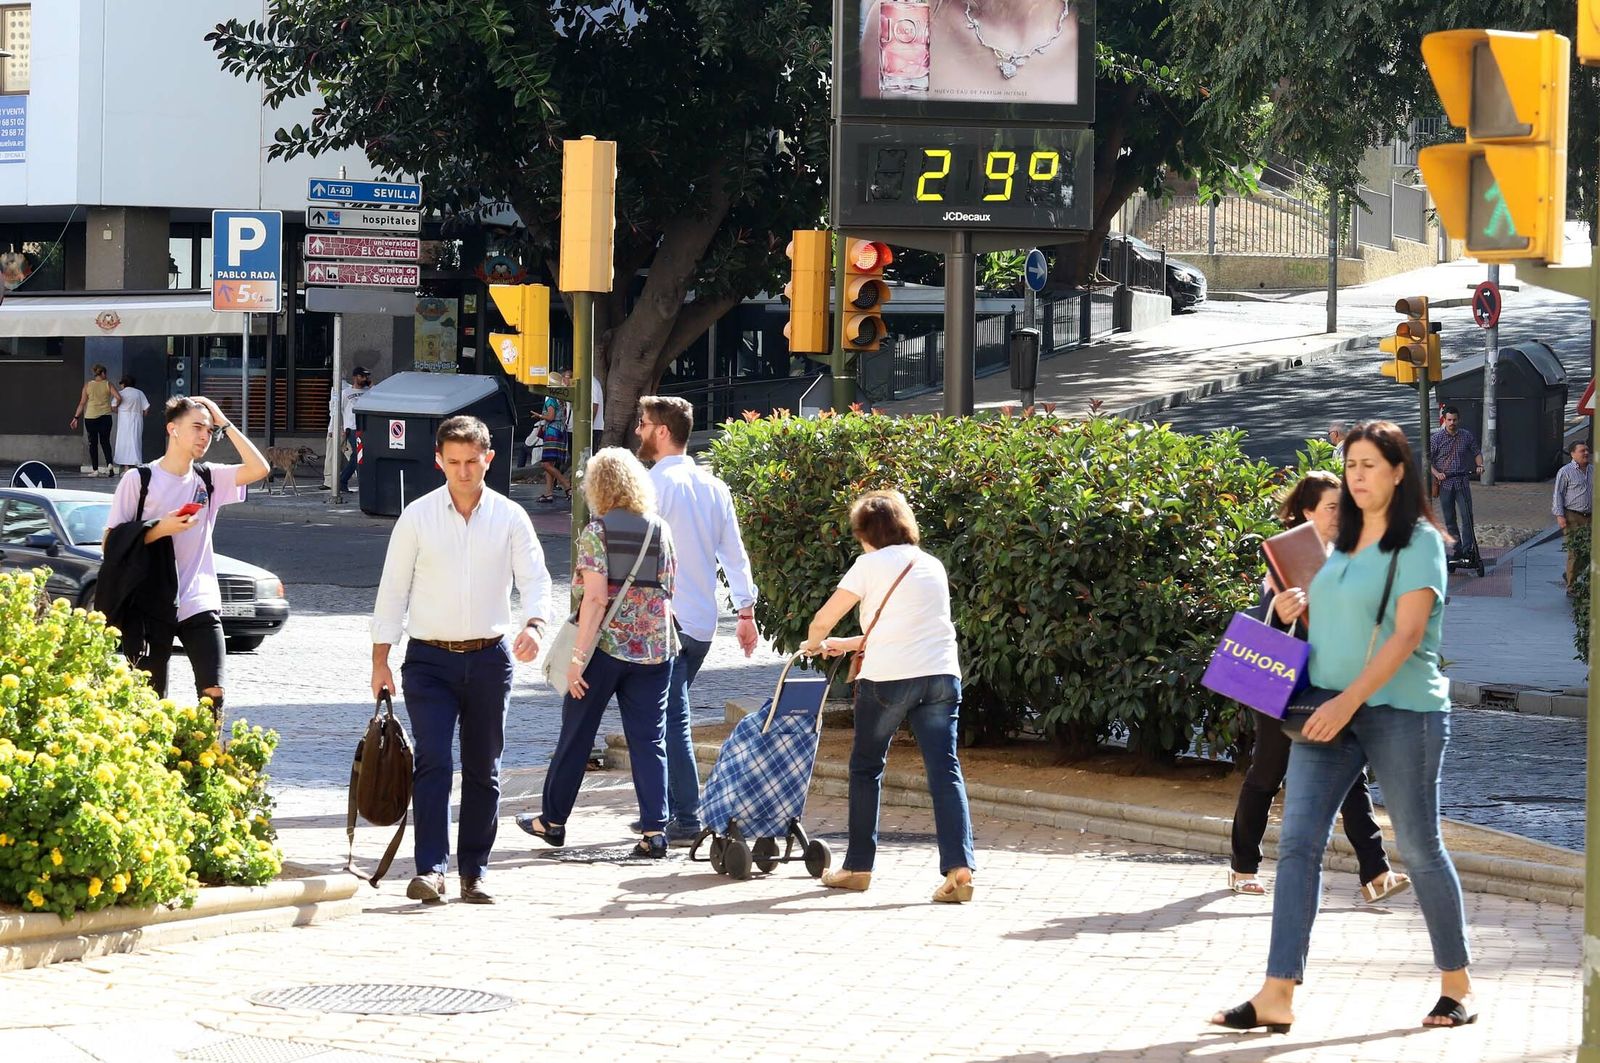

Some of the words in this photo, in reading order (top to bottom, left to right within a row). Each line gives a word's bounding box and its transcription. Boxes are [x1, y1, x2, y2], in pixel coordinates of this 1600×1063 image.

[330, 187, 351, 195] A-49
[373, 188, 417, 200] SEVILLA
[362, 214, 417, 226] hospitales
[942, 211, 991, 221] JCDecaux
[227, 216, 267, 267] P
[361, 246, 371, 256] El
[376, 247, 416, 258] Carmen
[217, 270, 247, 279] PABLO
[250, 271, 276, 280] RADA
[379, 267, 403, 275] ermita
[355, 274, 367, 282] La
[372, 274, 416, 285] Soledad
[1223, 638, 1296, 682] TUHORA
